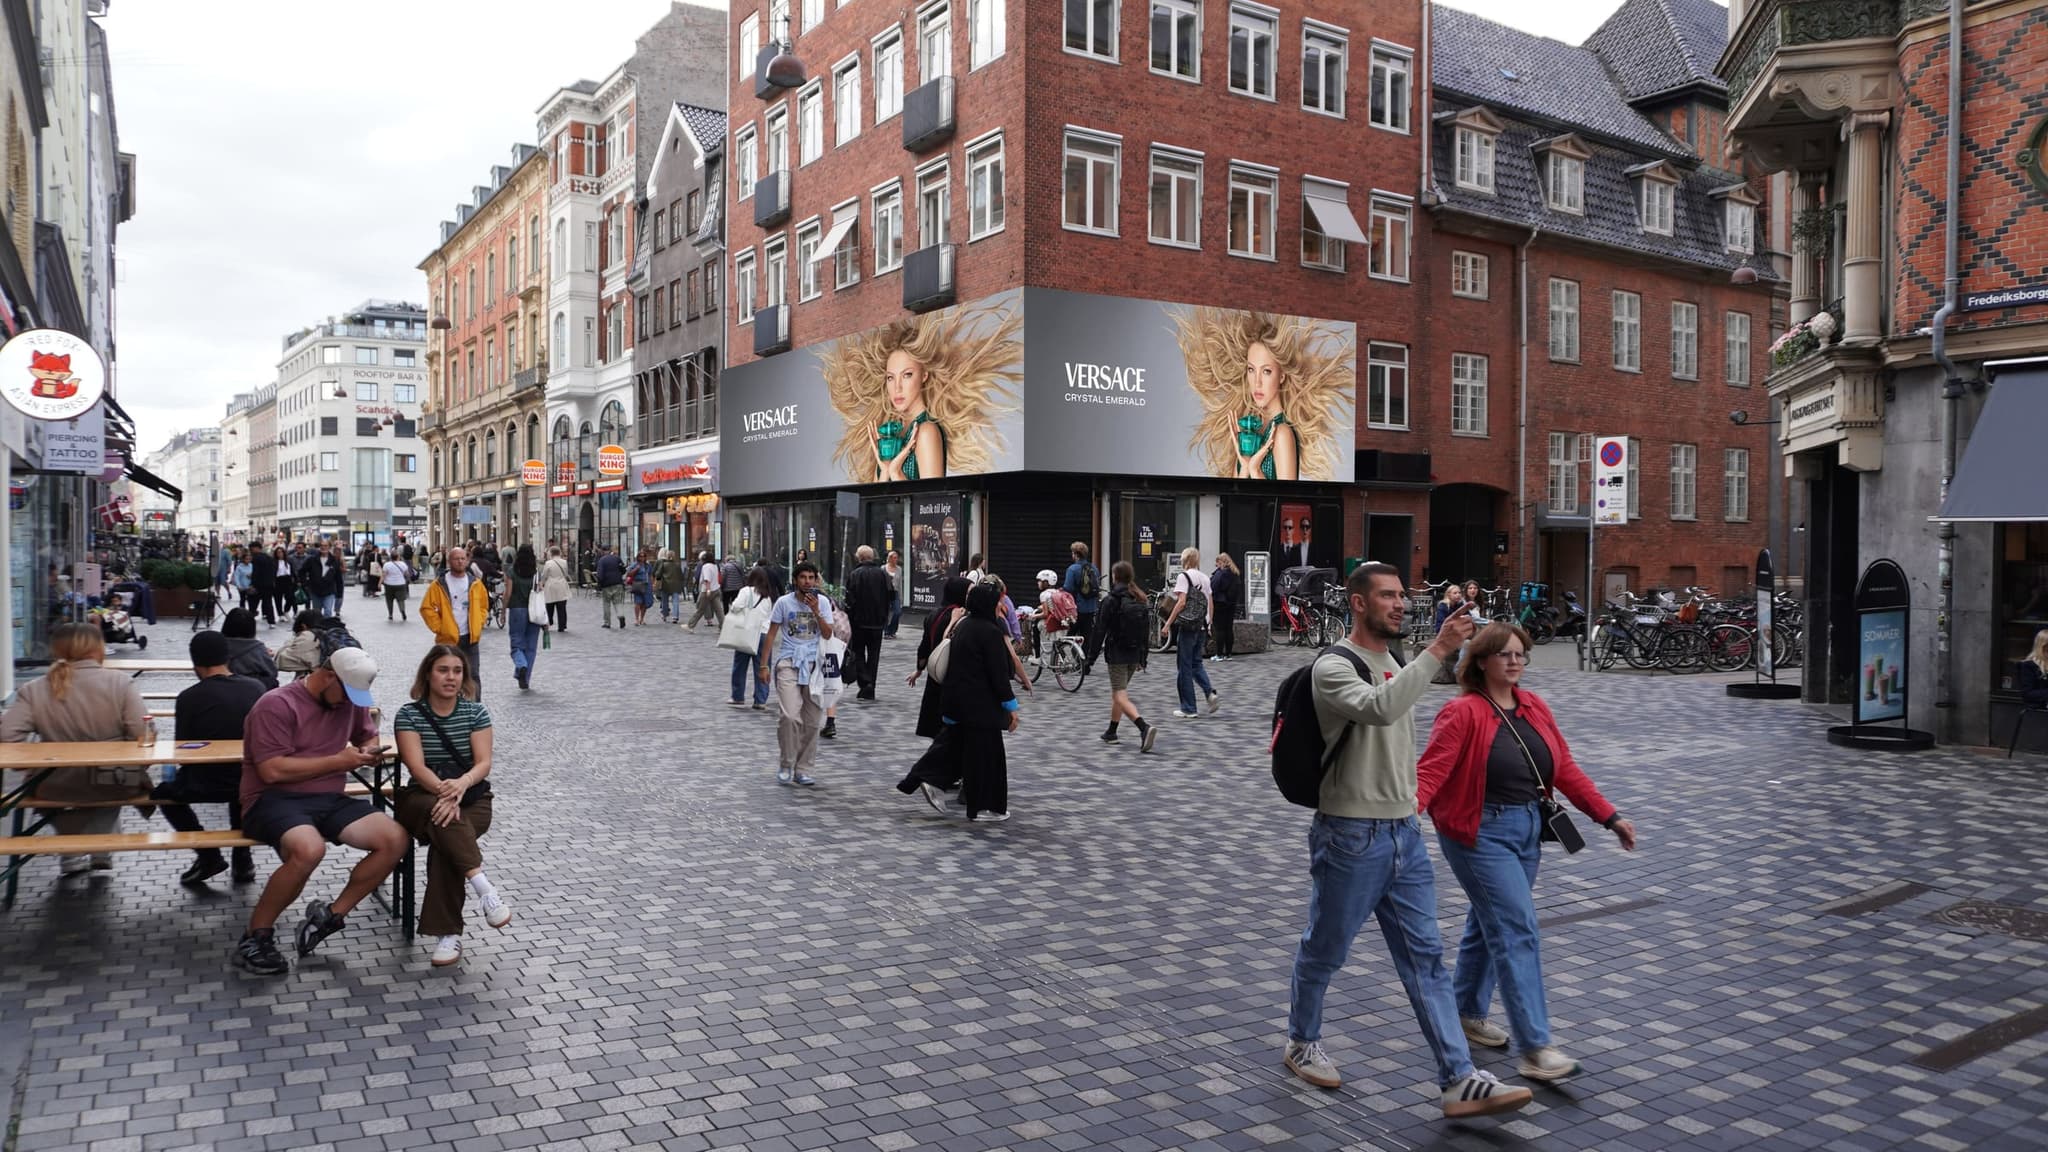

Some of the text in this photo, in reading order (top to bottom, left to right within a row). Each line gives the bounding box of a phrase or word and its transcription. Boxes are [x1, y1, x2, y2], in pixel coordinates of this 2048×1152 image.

[353, 369, 395, 379] ROOFTOP
[397, 373, 414, 381] BAR
[1065, 362, 1146, 393] VERSACE
[1064, 393, 1146, 406] CRYSTAL EMERALD
[356, 405, 395, 415] Scandic
[743, 404, 798, 432] VERSACE
[48, 433, 97, 443] PIERCING
[743, 428, 798, 443] CRYSTAL EMERALD
[48, 448, 97, 458] TATTOO
[600, 460, 625, 469] KING
[1864, 629, 1900, 642] SOMMER
